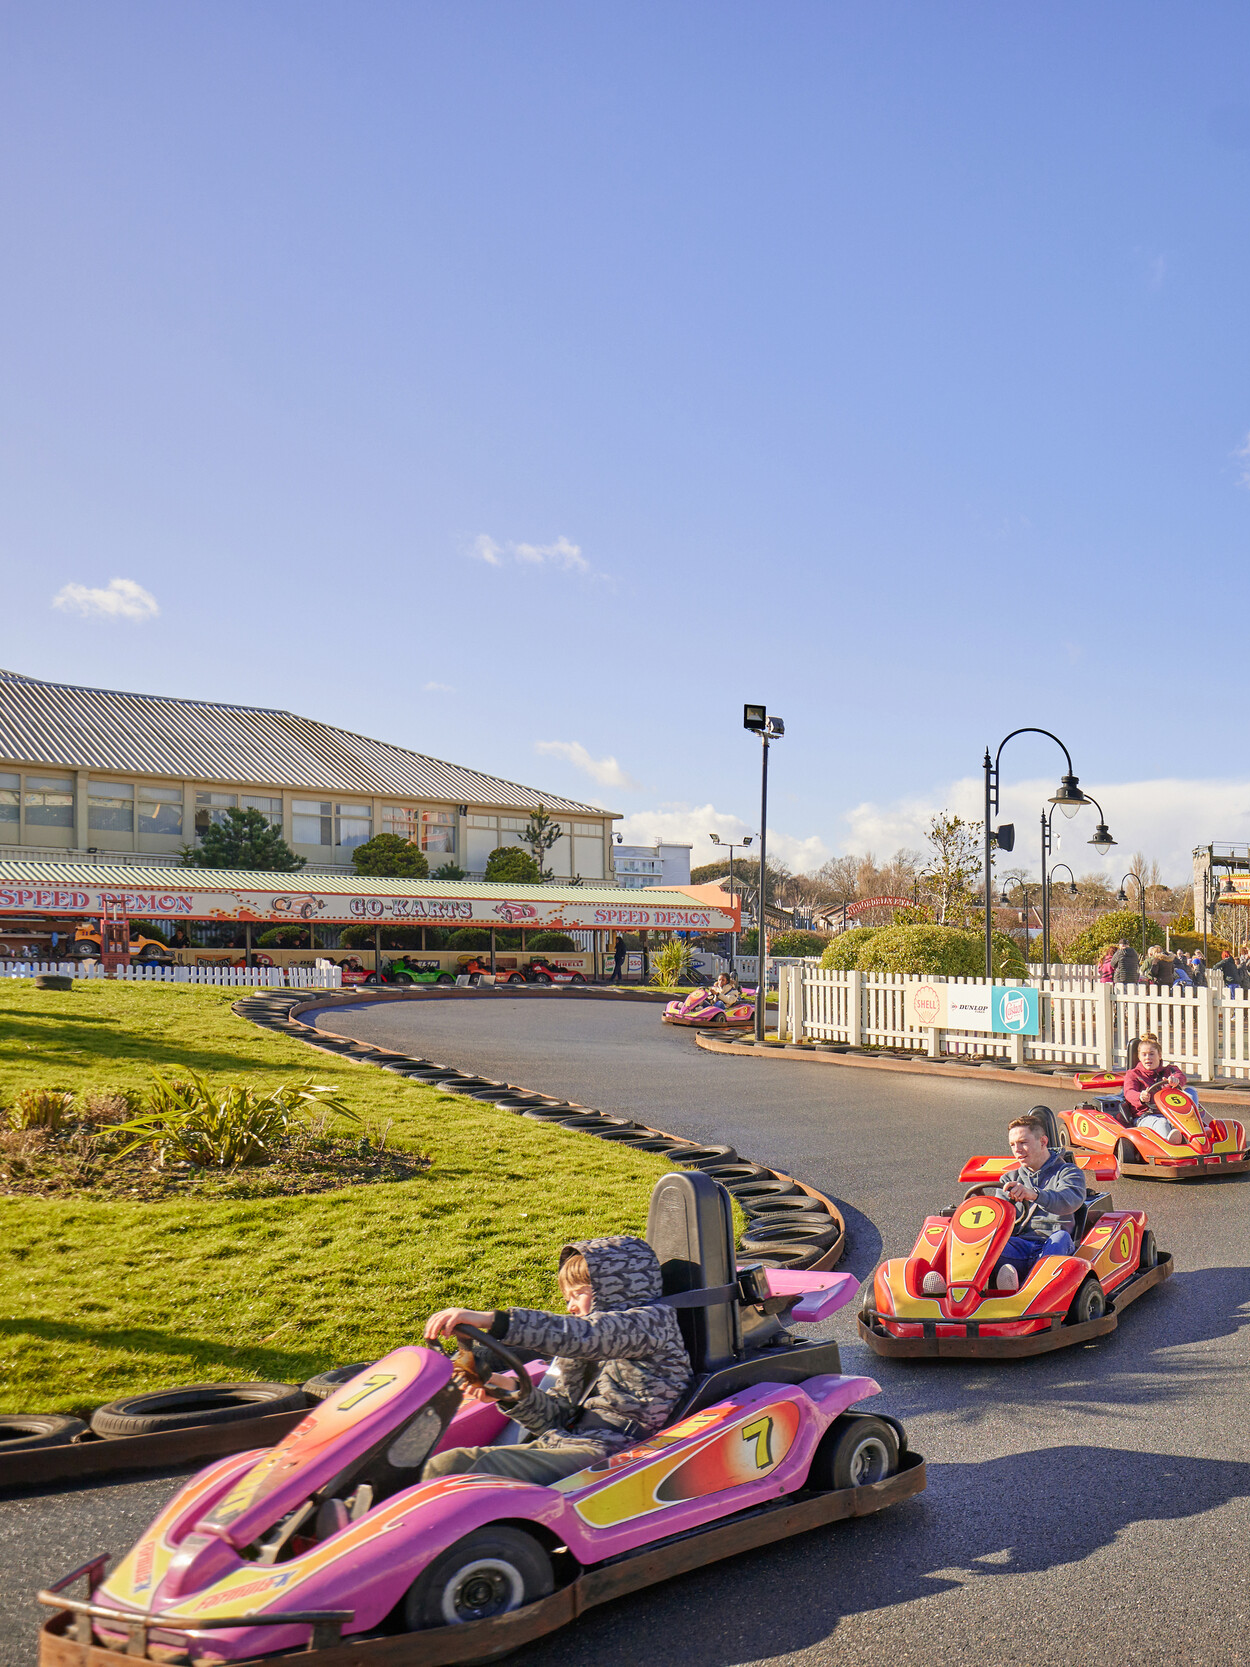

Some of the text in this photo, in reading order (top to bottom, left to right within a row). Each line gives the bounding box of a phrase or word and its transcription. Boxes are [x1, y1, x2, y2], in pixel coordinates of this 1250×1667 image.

[0, 889, 193, 913] SPEED DEMON
[350, 897, 473, 919] GO-KARTS
[594, 908, 711, 927] SPEED DEMON
[917, 999, 936, 1010] SHELL
[1171, 1096, 1181, 1105] 5
[971, 1211, 981, 1225] 1
[338, 1374, 397, 1412] 7
[742, 1416, 774, 1470] 7
